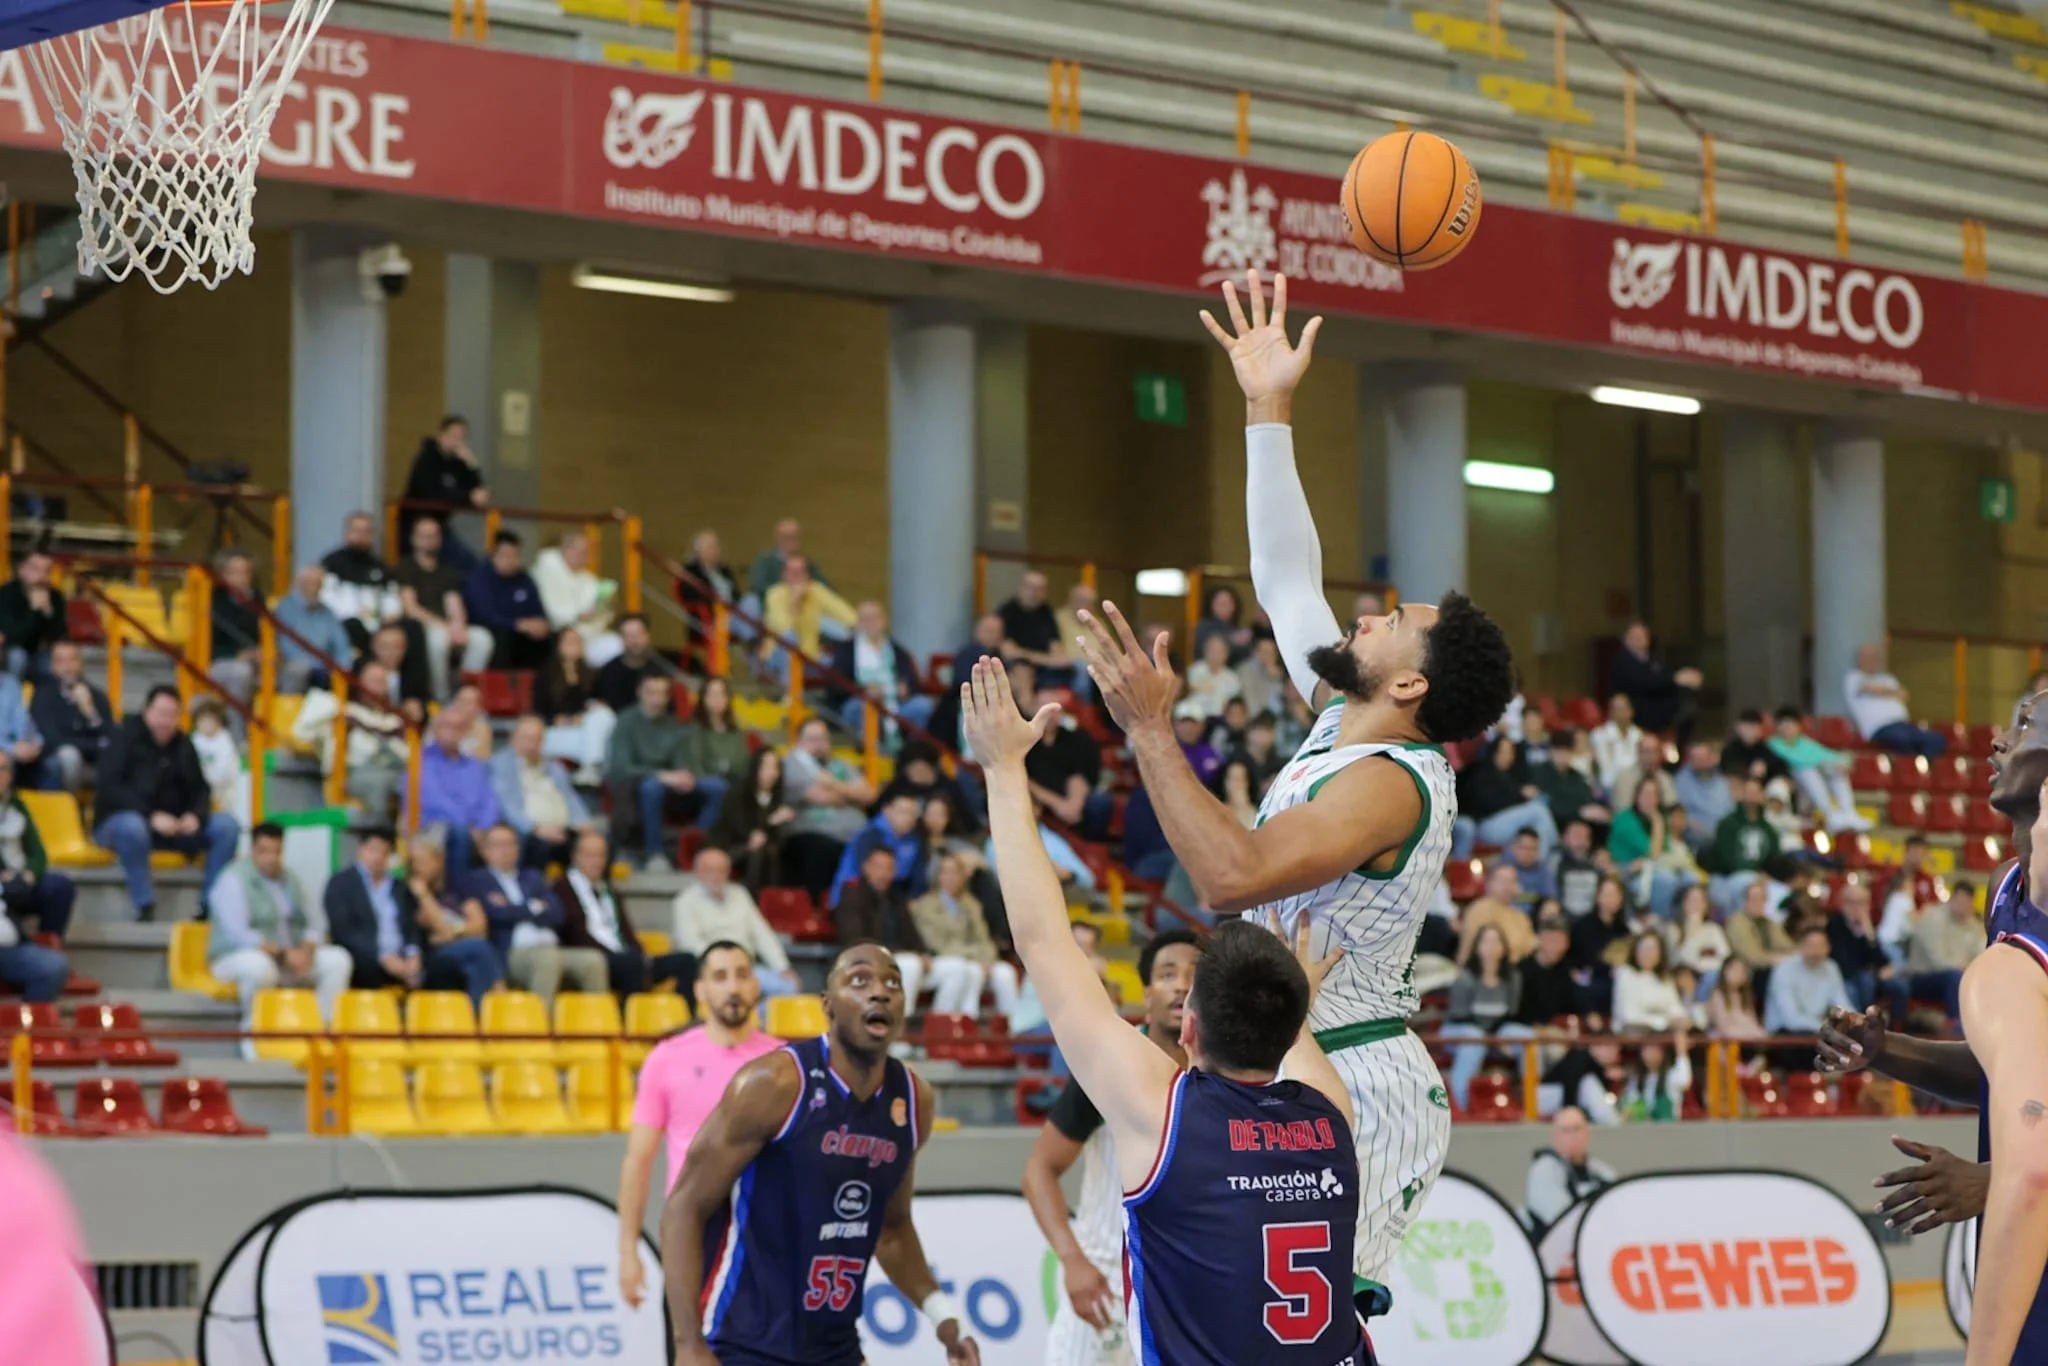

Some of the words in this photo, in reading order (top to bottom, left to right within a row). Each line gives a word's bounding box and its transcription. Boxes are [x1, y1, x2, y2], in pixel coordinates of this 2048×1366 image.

[712, 93, 1045, 220] IMDECO
[604, 180, 702, 220] Instituto
[704, 194, 817, 238] Municipal
[816, 208, 848, 240] de
[850, 211, 950, 251] Deportes
[1686, 243, 1923, 349] IMDECO
[1227, 1169, 1318, 1190] TRADICIÓN
[1265, 1187, 1321, 1203] casera
[408, 1265, 614, 1318] REALE
[803, 1255, 866, 1311] 55
[1262, 1221, 1332, 1345] 5
[417, 1323, 623, 1363] SEGUROS
